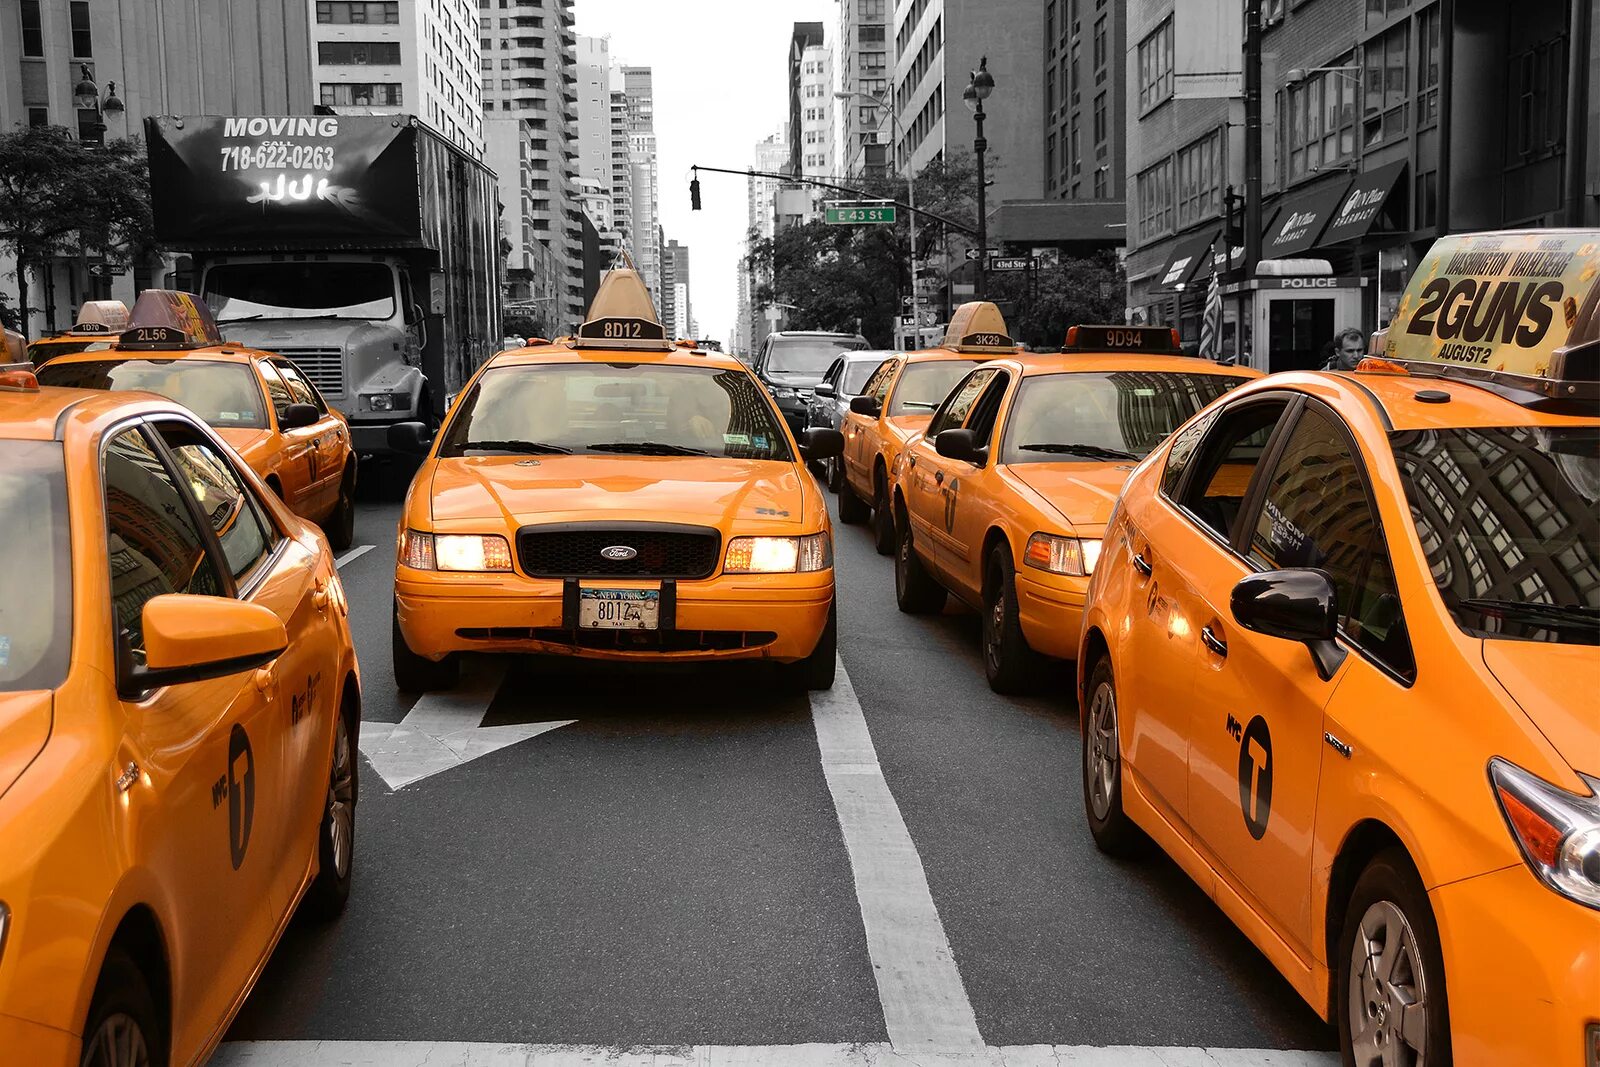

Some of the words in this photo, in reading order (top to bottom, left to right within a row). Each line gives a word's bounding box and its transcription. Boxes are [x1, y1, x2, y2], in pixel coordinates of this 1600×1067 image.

[223, 118, 338, 137] MOVING
[221, 145, 334, 171] 718-622-0263
[838, 211, 846, 220] E
[849, 210, 865, 220] 43
[869, 210, 883, 220] St
[1537, 240, 1566, 250] MARK
[996, 260, 1013, 268] 43rd
[1444, 252, 1513, 276] WASHINGTON
[1507, 251, 1574, 278] WAHLBERG
[1281, 278, 1337, 288] POLICE
[137, 329, 167, 341] 2L56
[604, 322, 641, 338] 8D12
[975, 334, 1000, 345] 3K29
[1106, 330, 1142, 347] 9D94
[1438, 343, 1482, 361] AUGUST
[1480, 348, 1492, 364] 2
[600, 591, 618, 600] NEW
[620, 591, 640, 600] YORK
[1226, 712, 1242, 743] NYC
[212, 773, 228, 810] NYC
